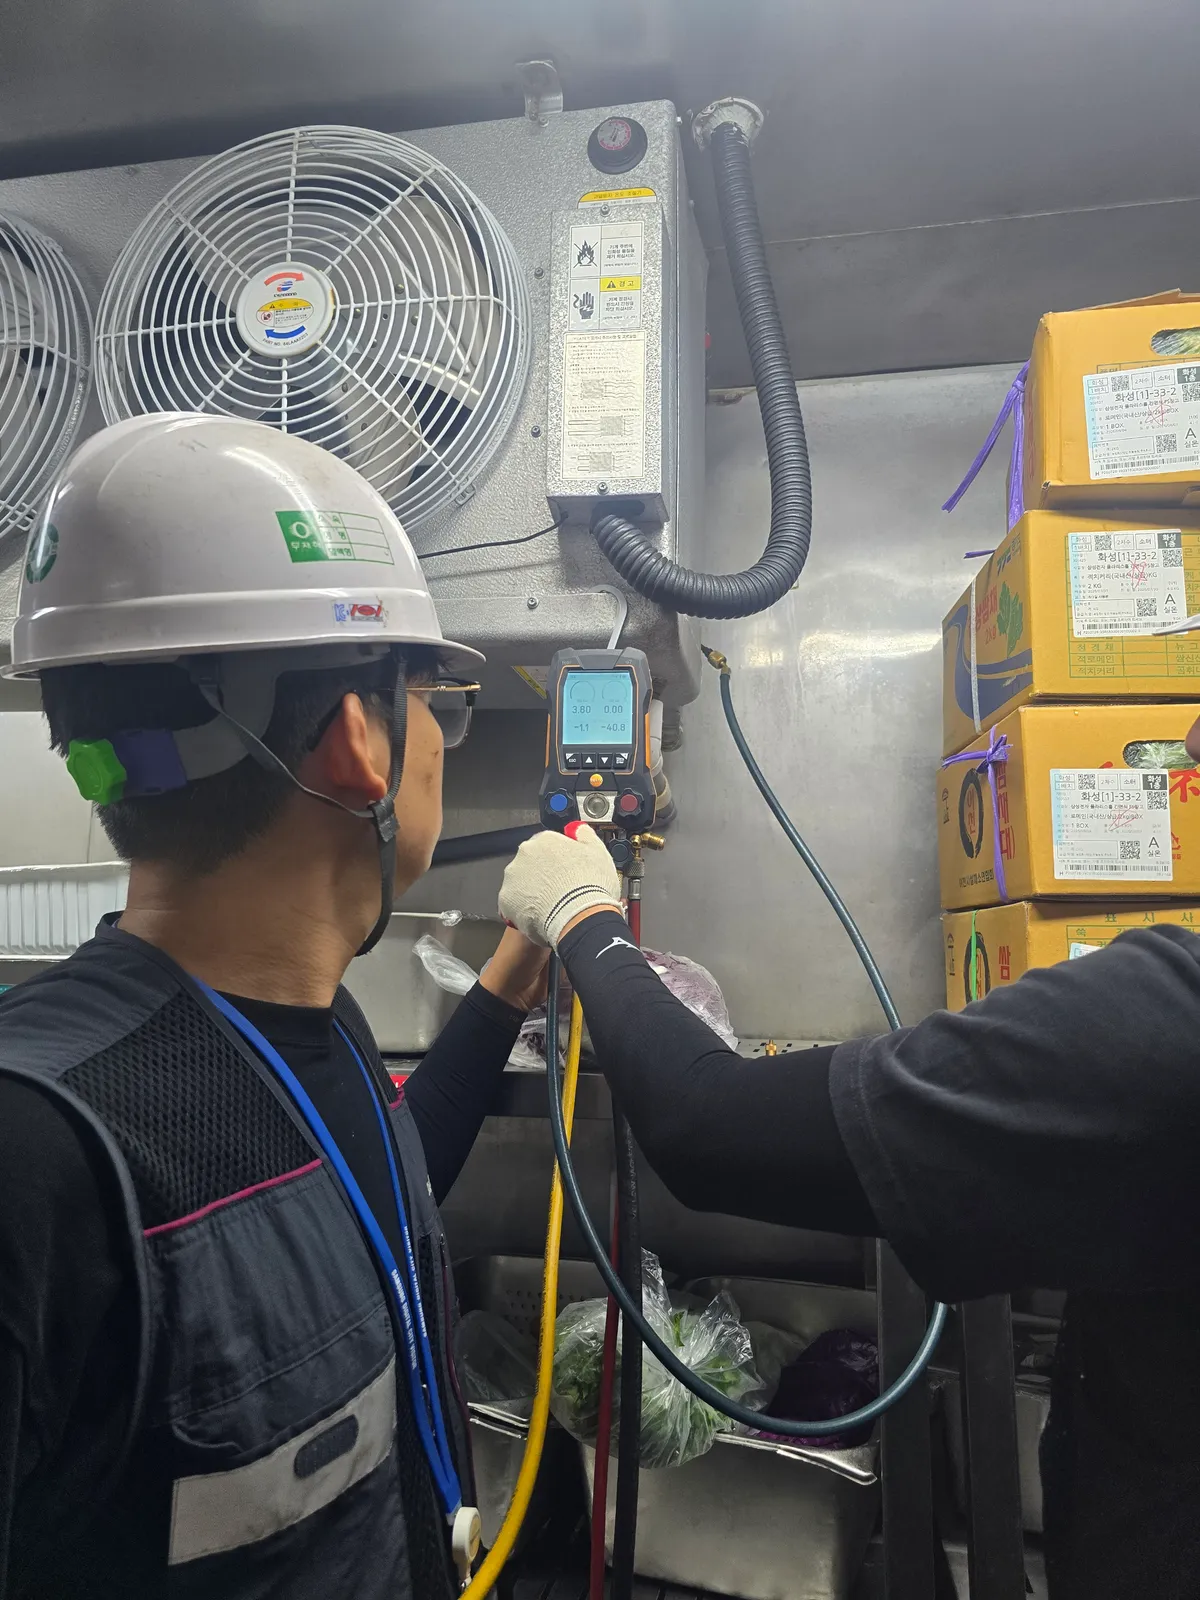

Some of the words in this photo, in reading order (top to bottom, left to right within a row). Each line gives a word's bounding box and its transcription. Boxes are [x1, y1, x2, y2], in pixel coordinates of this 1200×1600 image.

[1115, 388, 1177, 402] 화성[1]-33-2
[1185, 428, 1196, 439] A
[1098, 552, 1156, 562] 화성[1]-33-2
[1165, 594, 1176, 604] A
[572, 706, 591, 714] 3.80
[604, 706, 622, 714] 0.00
[574, 724, 589, 732] -1.1
[601, 724, 626, 732] -40.8
[1081, 792, 1141, 802] 화성[1]-33-2
[1148, 836, 1160, 848] A
[391, 1268, 406, 1303] SAMSUNG
